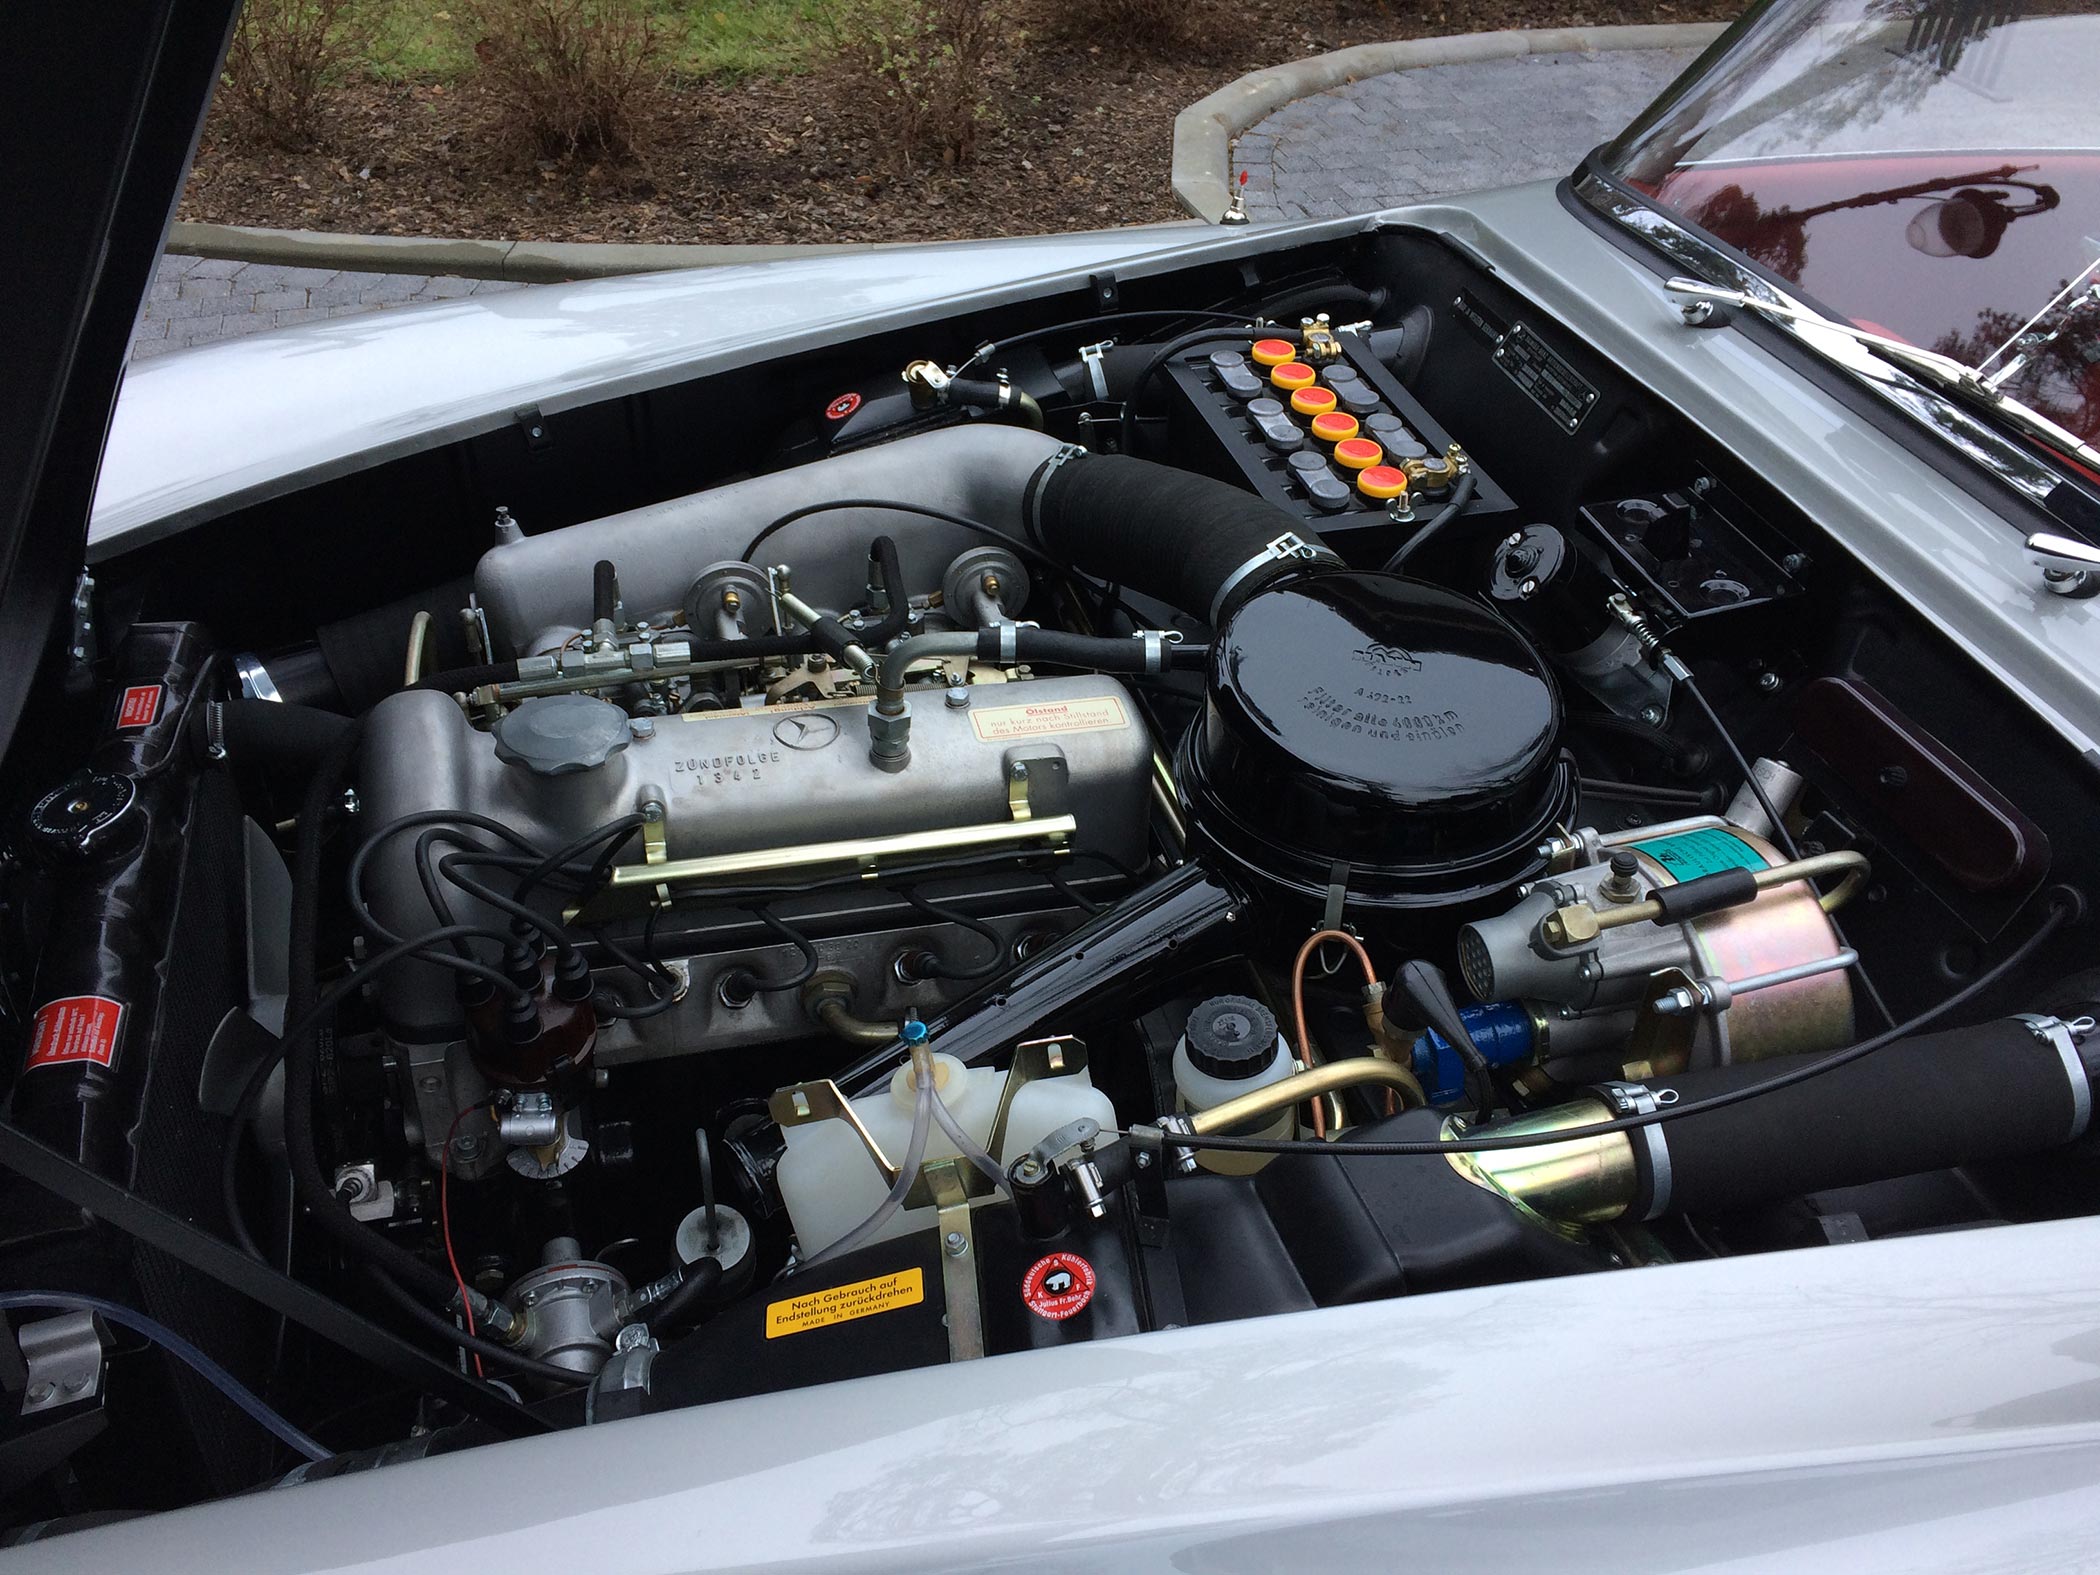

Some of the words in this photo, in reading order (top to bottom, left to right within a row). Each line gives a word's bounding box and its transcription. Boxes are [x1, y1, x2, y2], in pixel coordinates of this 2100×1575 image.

[990, 719, 1007, 728] nur
[1010, 715, 1032, 727] kurz
[1036, 711, 1061, 723] nach
[1063, 708, 1109, 721] Stillstand
[1025, 705, 1068, 716] Ölstand
[992, 726, 1010, 736] des
[1012, 722, 1048, 734] Motors
[1367, 729, 1401, 742] und
[791, 1297, 820, 1311] Nach
[823, 1284, 877, 1304] Gebrauch
[879, 1277, 898, 1290] auf
[776, 1304, 837, 1325] Endstellung
[840, 1285, 913, 1309] zurückdrehen
[1039, 1299, 1058, 1308] Julius
[802, 1317, 825, 1327] MADE
[833, 1312, 843, 1320] IN
[849, 1301, 890, 1317] GERMANY
